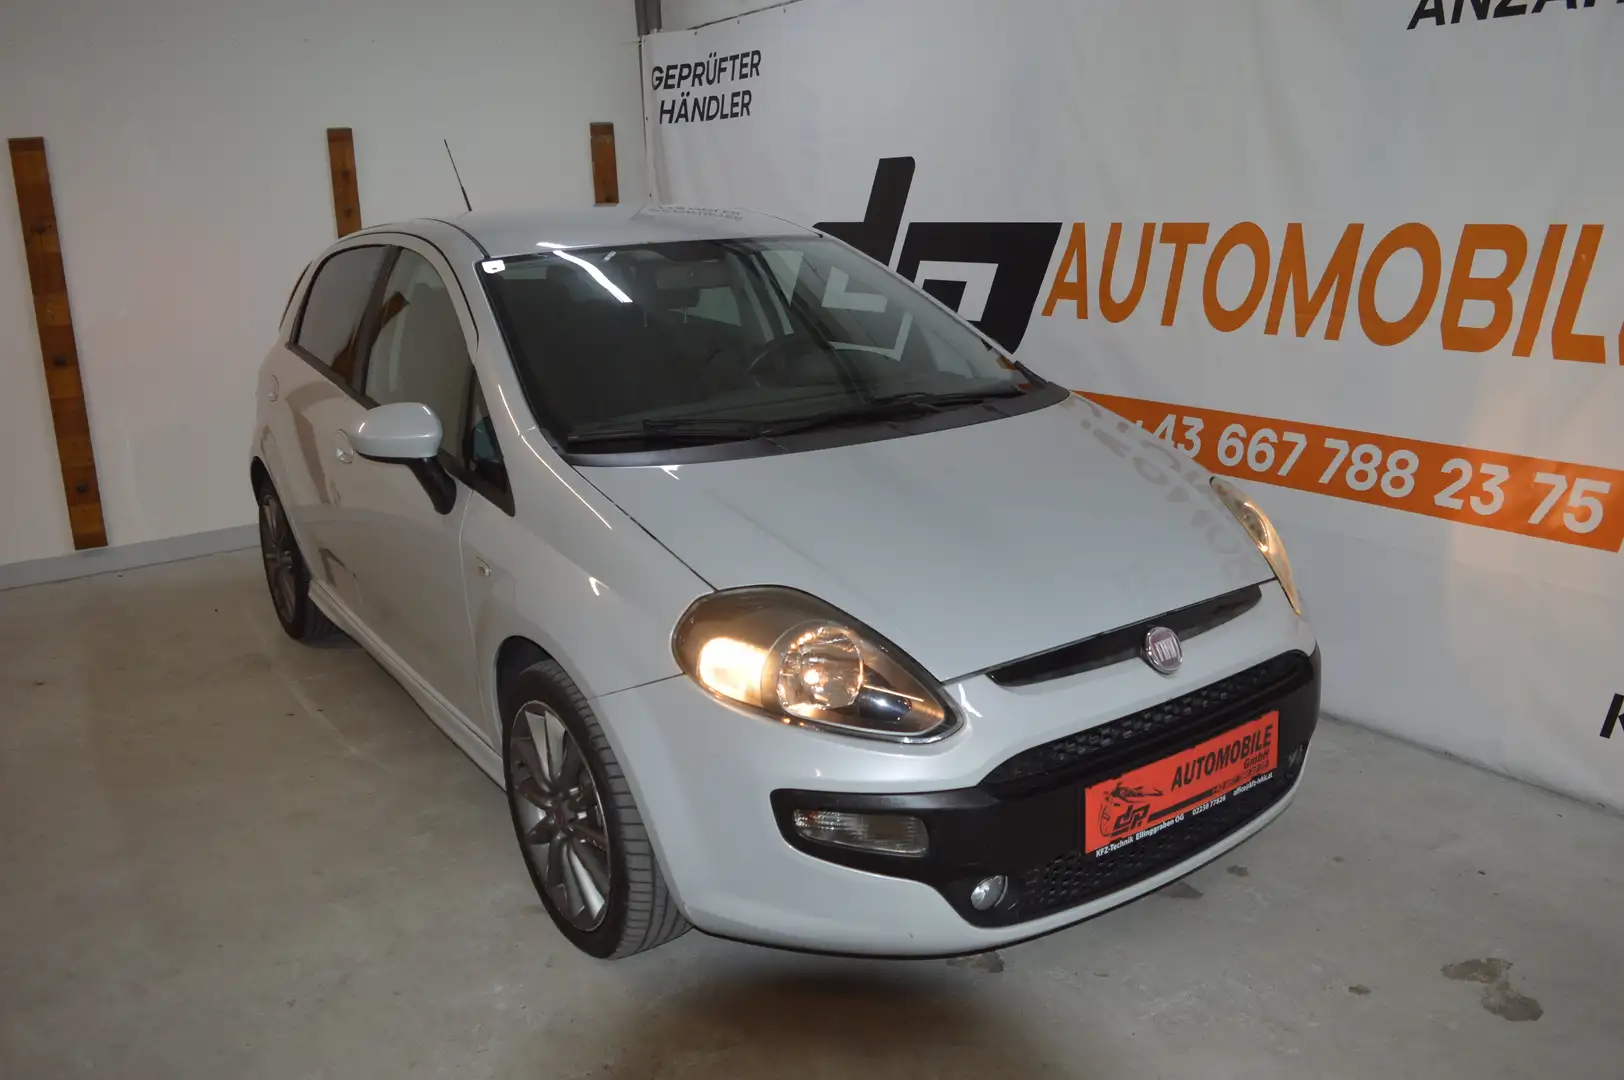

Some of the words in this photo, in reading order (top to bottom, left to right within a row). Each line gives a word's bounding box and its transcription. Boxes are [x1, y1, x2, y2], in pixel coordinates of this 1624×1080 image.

[651, 50, 762, 91] GEPRÜFTER
[659, 90, 753, 125] HÄNDLER
[1041, 222, 1624, 366] AUTOMOBIL
[1136, 413, 1205, 459] 43
[1217, 423, 1308, 477] 667
[1318, 437, 1419, 498] 788
[1433, 457, 1511, 516] 23
[1527, 471, 1611, 534] 75
[1170, 723, 1273, 792] AUTOMOBILE
[1095, 835, 1134, 858] KFZ-Technik
